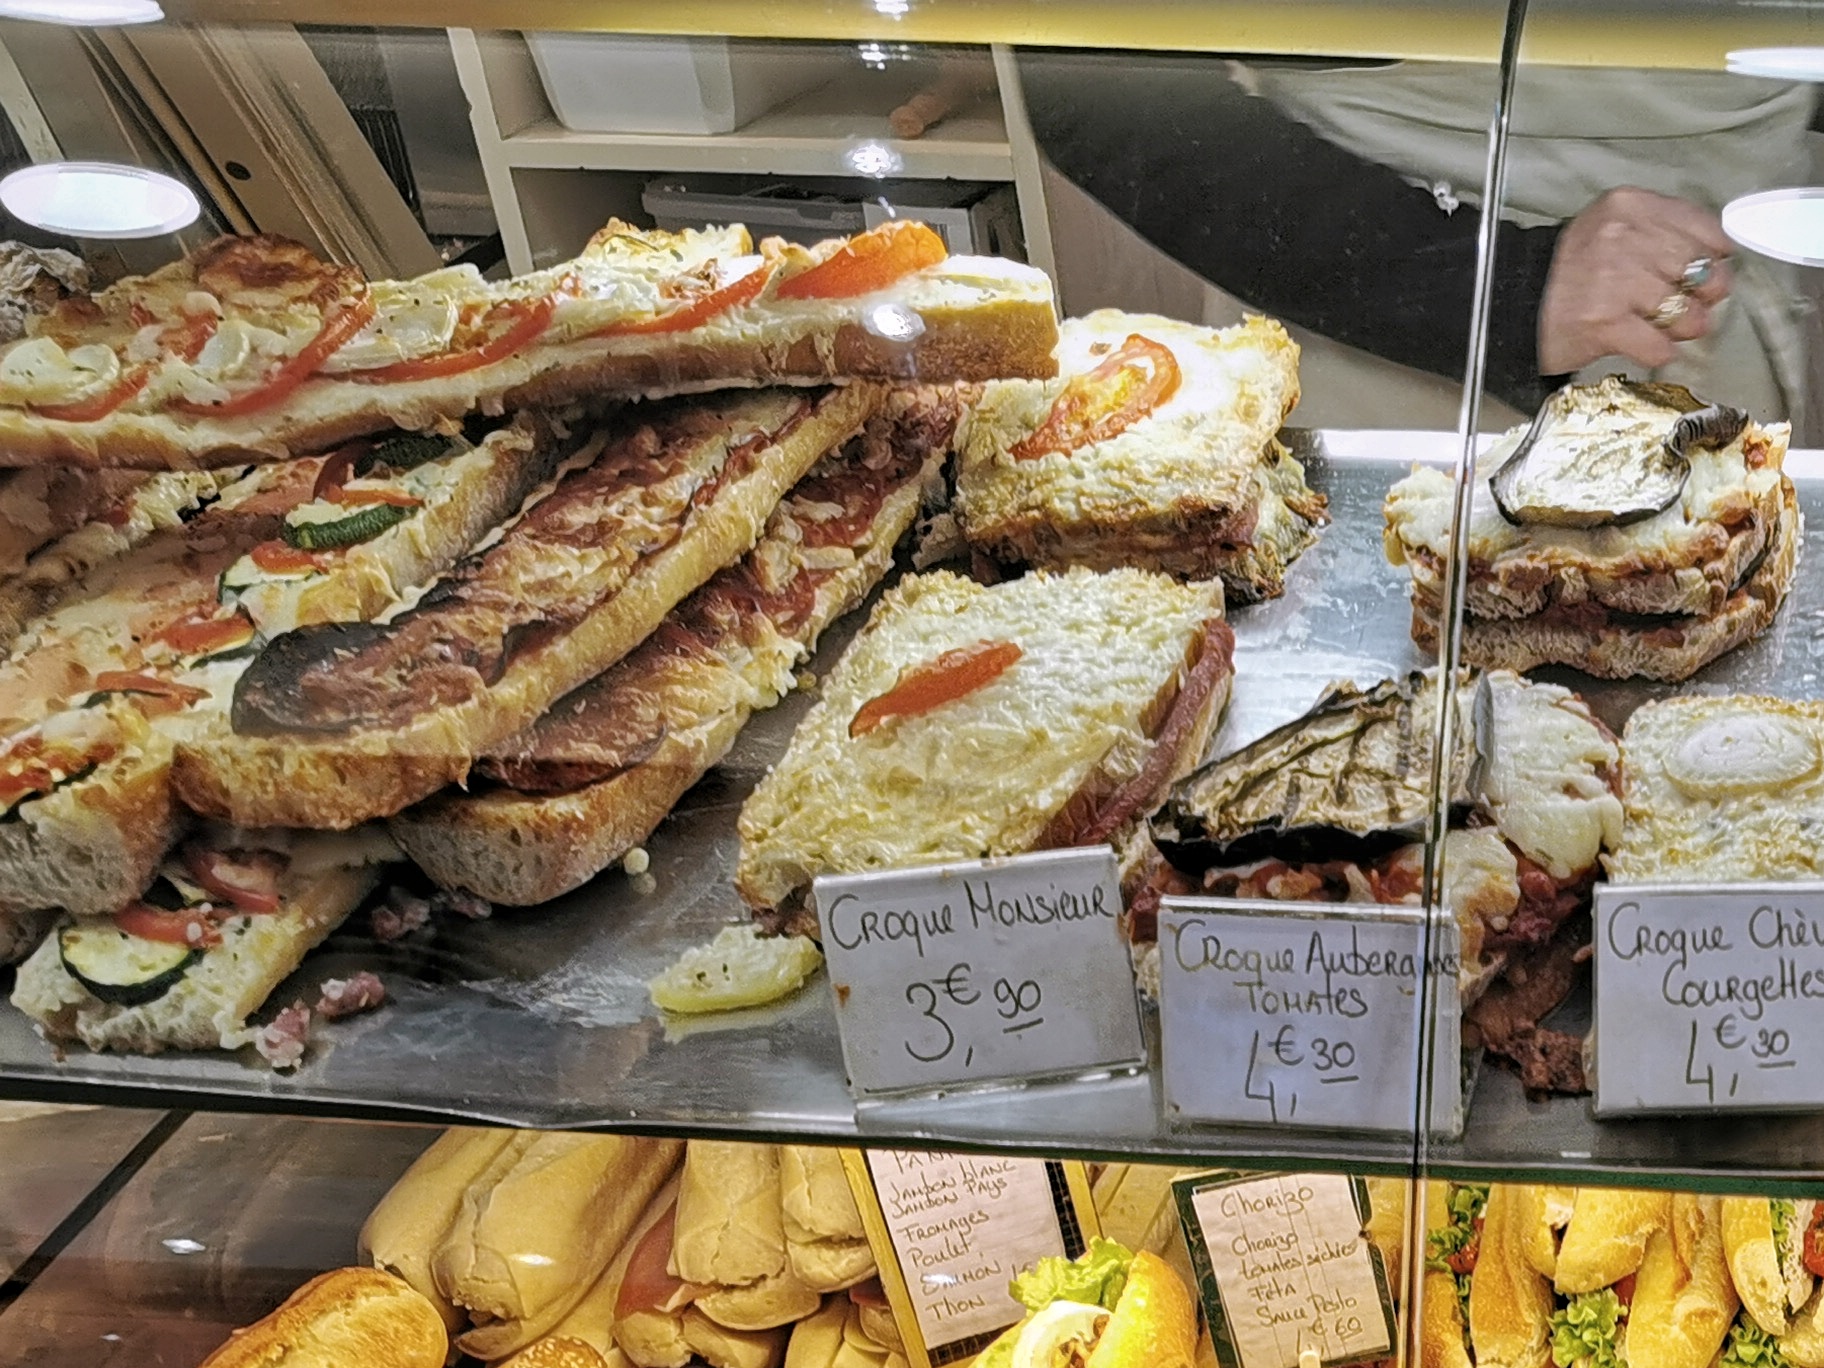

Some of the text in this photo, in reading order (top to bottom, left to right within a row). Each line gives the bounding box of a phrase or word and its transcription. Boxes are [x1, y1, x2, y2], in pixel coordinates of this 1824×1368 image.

[829, 894, 956, 957] Croque
[1608, 902, 1734, 970] Croque
[1175, 919, 1294, 989] Croque
[1220, 1186, 1314, 1218] Chorizo
[906, 1232, 971, 1268] Poulet
[1231, 1231, 1299, 1257] Chorizo
